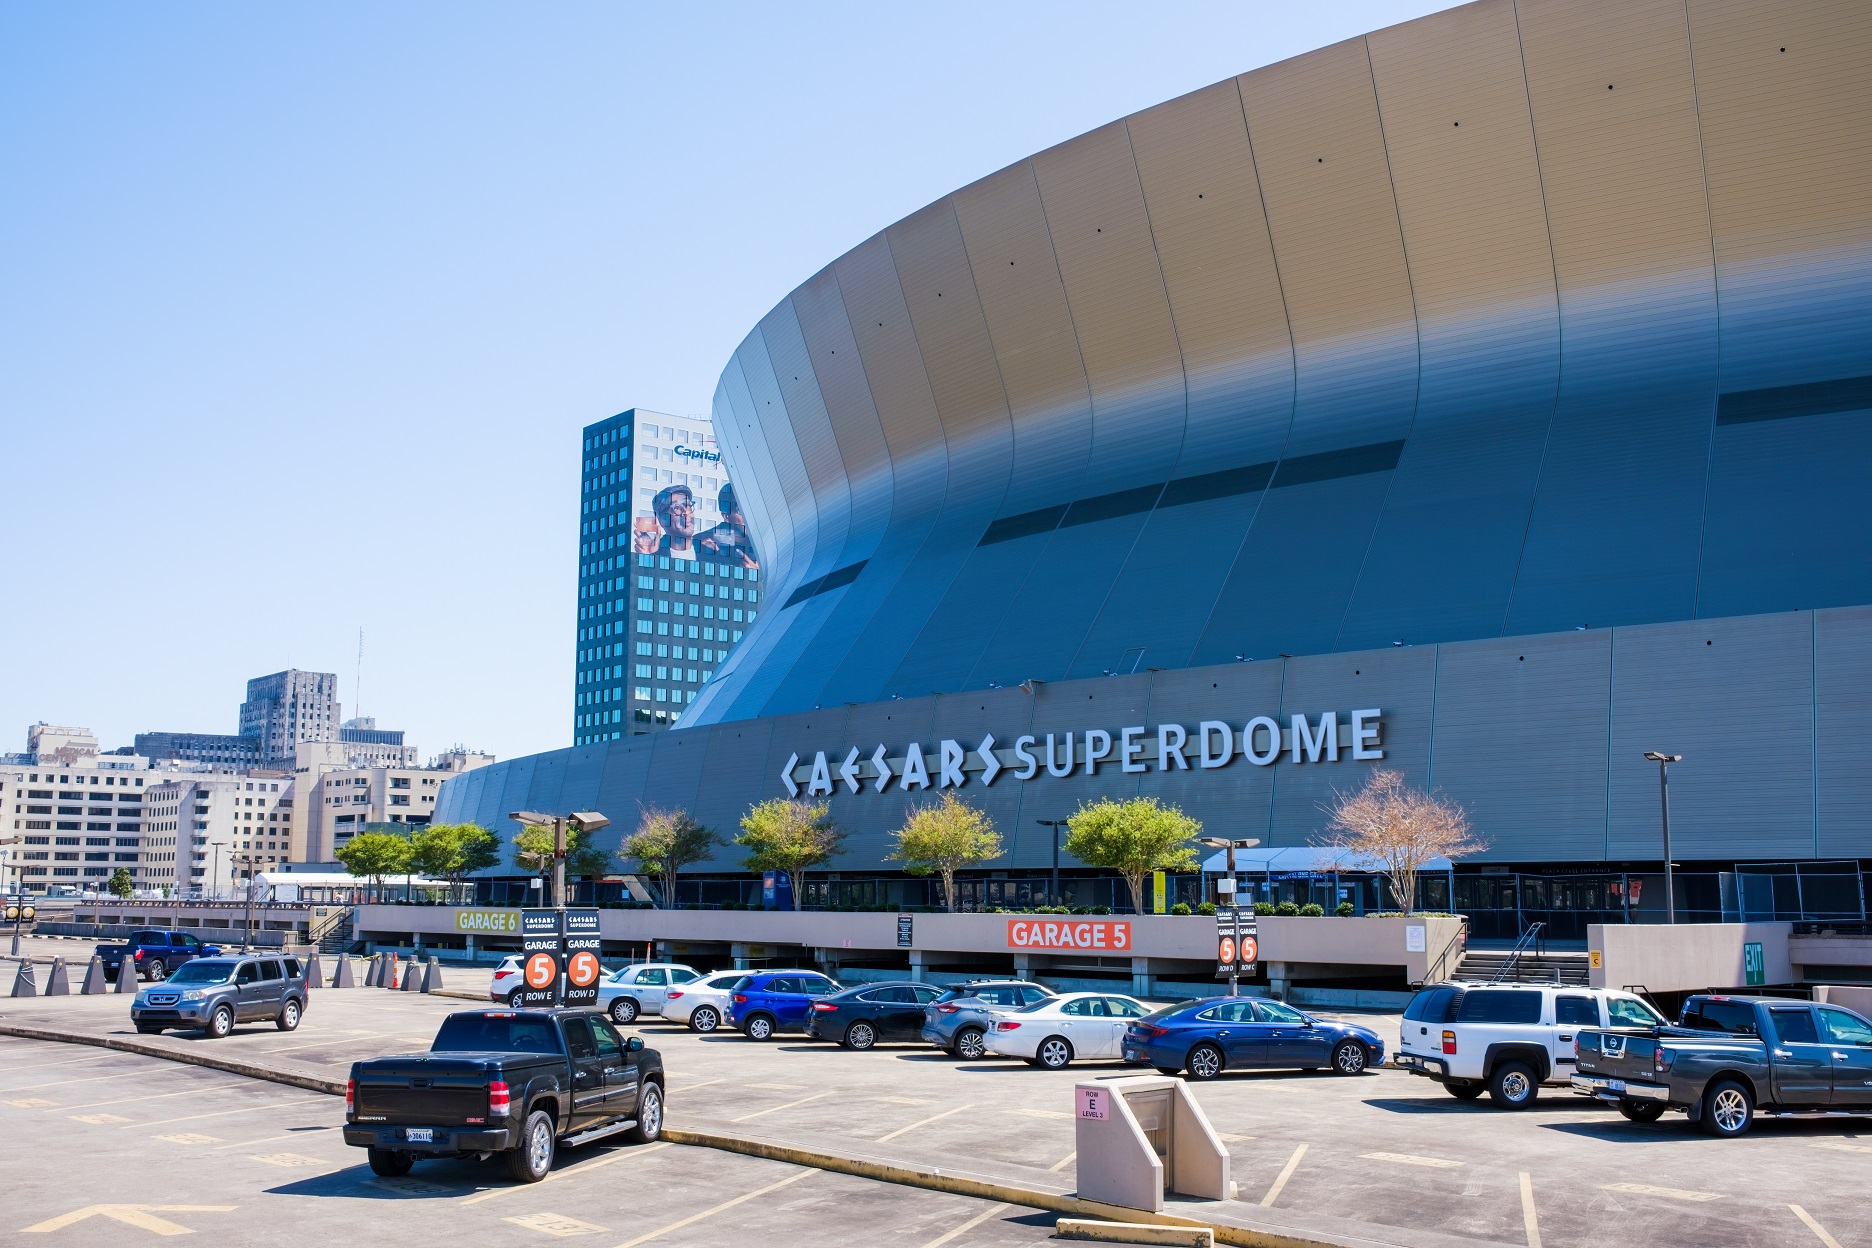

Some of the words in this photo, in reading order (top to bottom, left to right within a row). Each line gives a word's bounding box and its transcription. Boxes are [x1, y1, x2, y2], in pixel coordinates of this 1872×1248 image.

[674, 445, 721, 461] Capital
[54, 747, 95, 756] MEDICAL
[781, 732, 1001, 798] CAESARS
[1014, 708, 1384, 780] SUPERDOME
[39, 754, 78, 763] CENTER
[460, 913, 506, 930] GARAGE
[508, 914, 516, 931] 6
[1012, 922, 1106, 948] GARAGE
[1113, 924, 1127, 948] 5
[1219, 928, 1235, 936] GARAGE
[525, 941, 558, 950] GARAGE
[568, 939, 600, 949] GARAGE
[1245, 939, 1254, 960] 5
[1223, 940, 1232, 961] 5
[1745, 944, 1763, 972] EXIT
[533, 957, 549, 985] 5
[576, 956, 592, 983] 5
[526, 992, 546, 1001] ROW
[547, 991, 553, 1000] E
[568, 990, 588, 999] ROW
[589, 989, 596, 998] D
[1085, 1090, 1099, 1098] ROW
[1089, 1099, 1096, 1110] E
[1082, 1110, 1098, 1118] LEVEL
